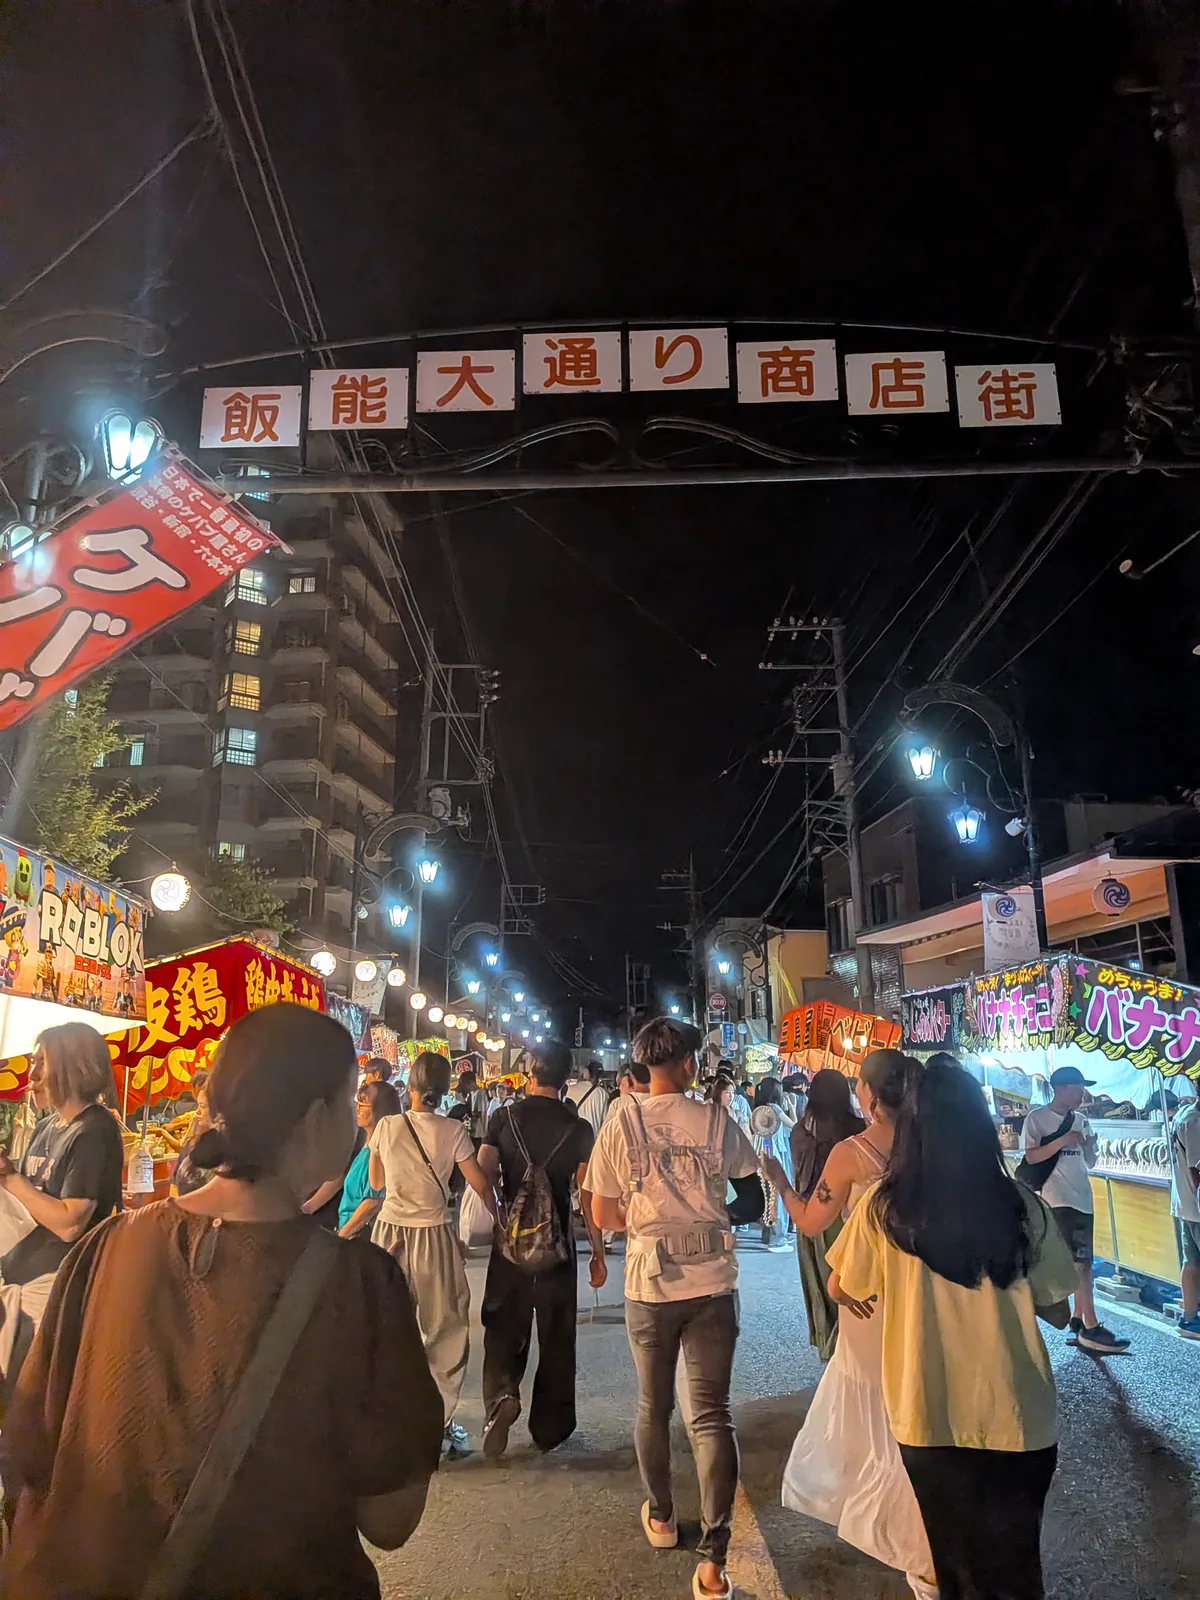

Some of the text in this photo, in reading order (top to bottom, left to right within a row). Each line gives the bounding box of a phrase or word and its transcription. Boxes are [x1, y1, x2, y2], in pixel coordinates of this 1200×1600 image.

[222, 334, 1037, 444] 飯能大通り商店街
[0, 527, 187, 702] ケバ
[39, 888, 144, 974] ROBLOX
[976, 982, 1052, 1038] バナナチョコ
